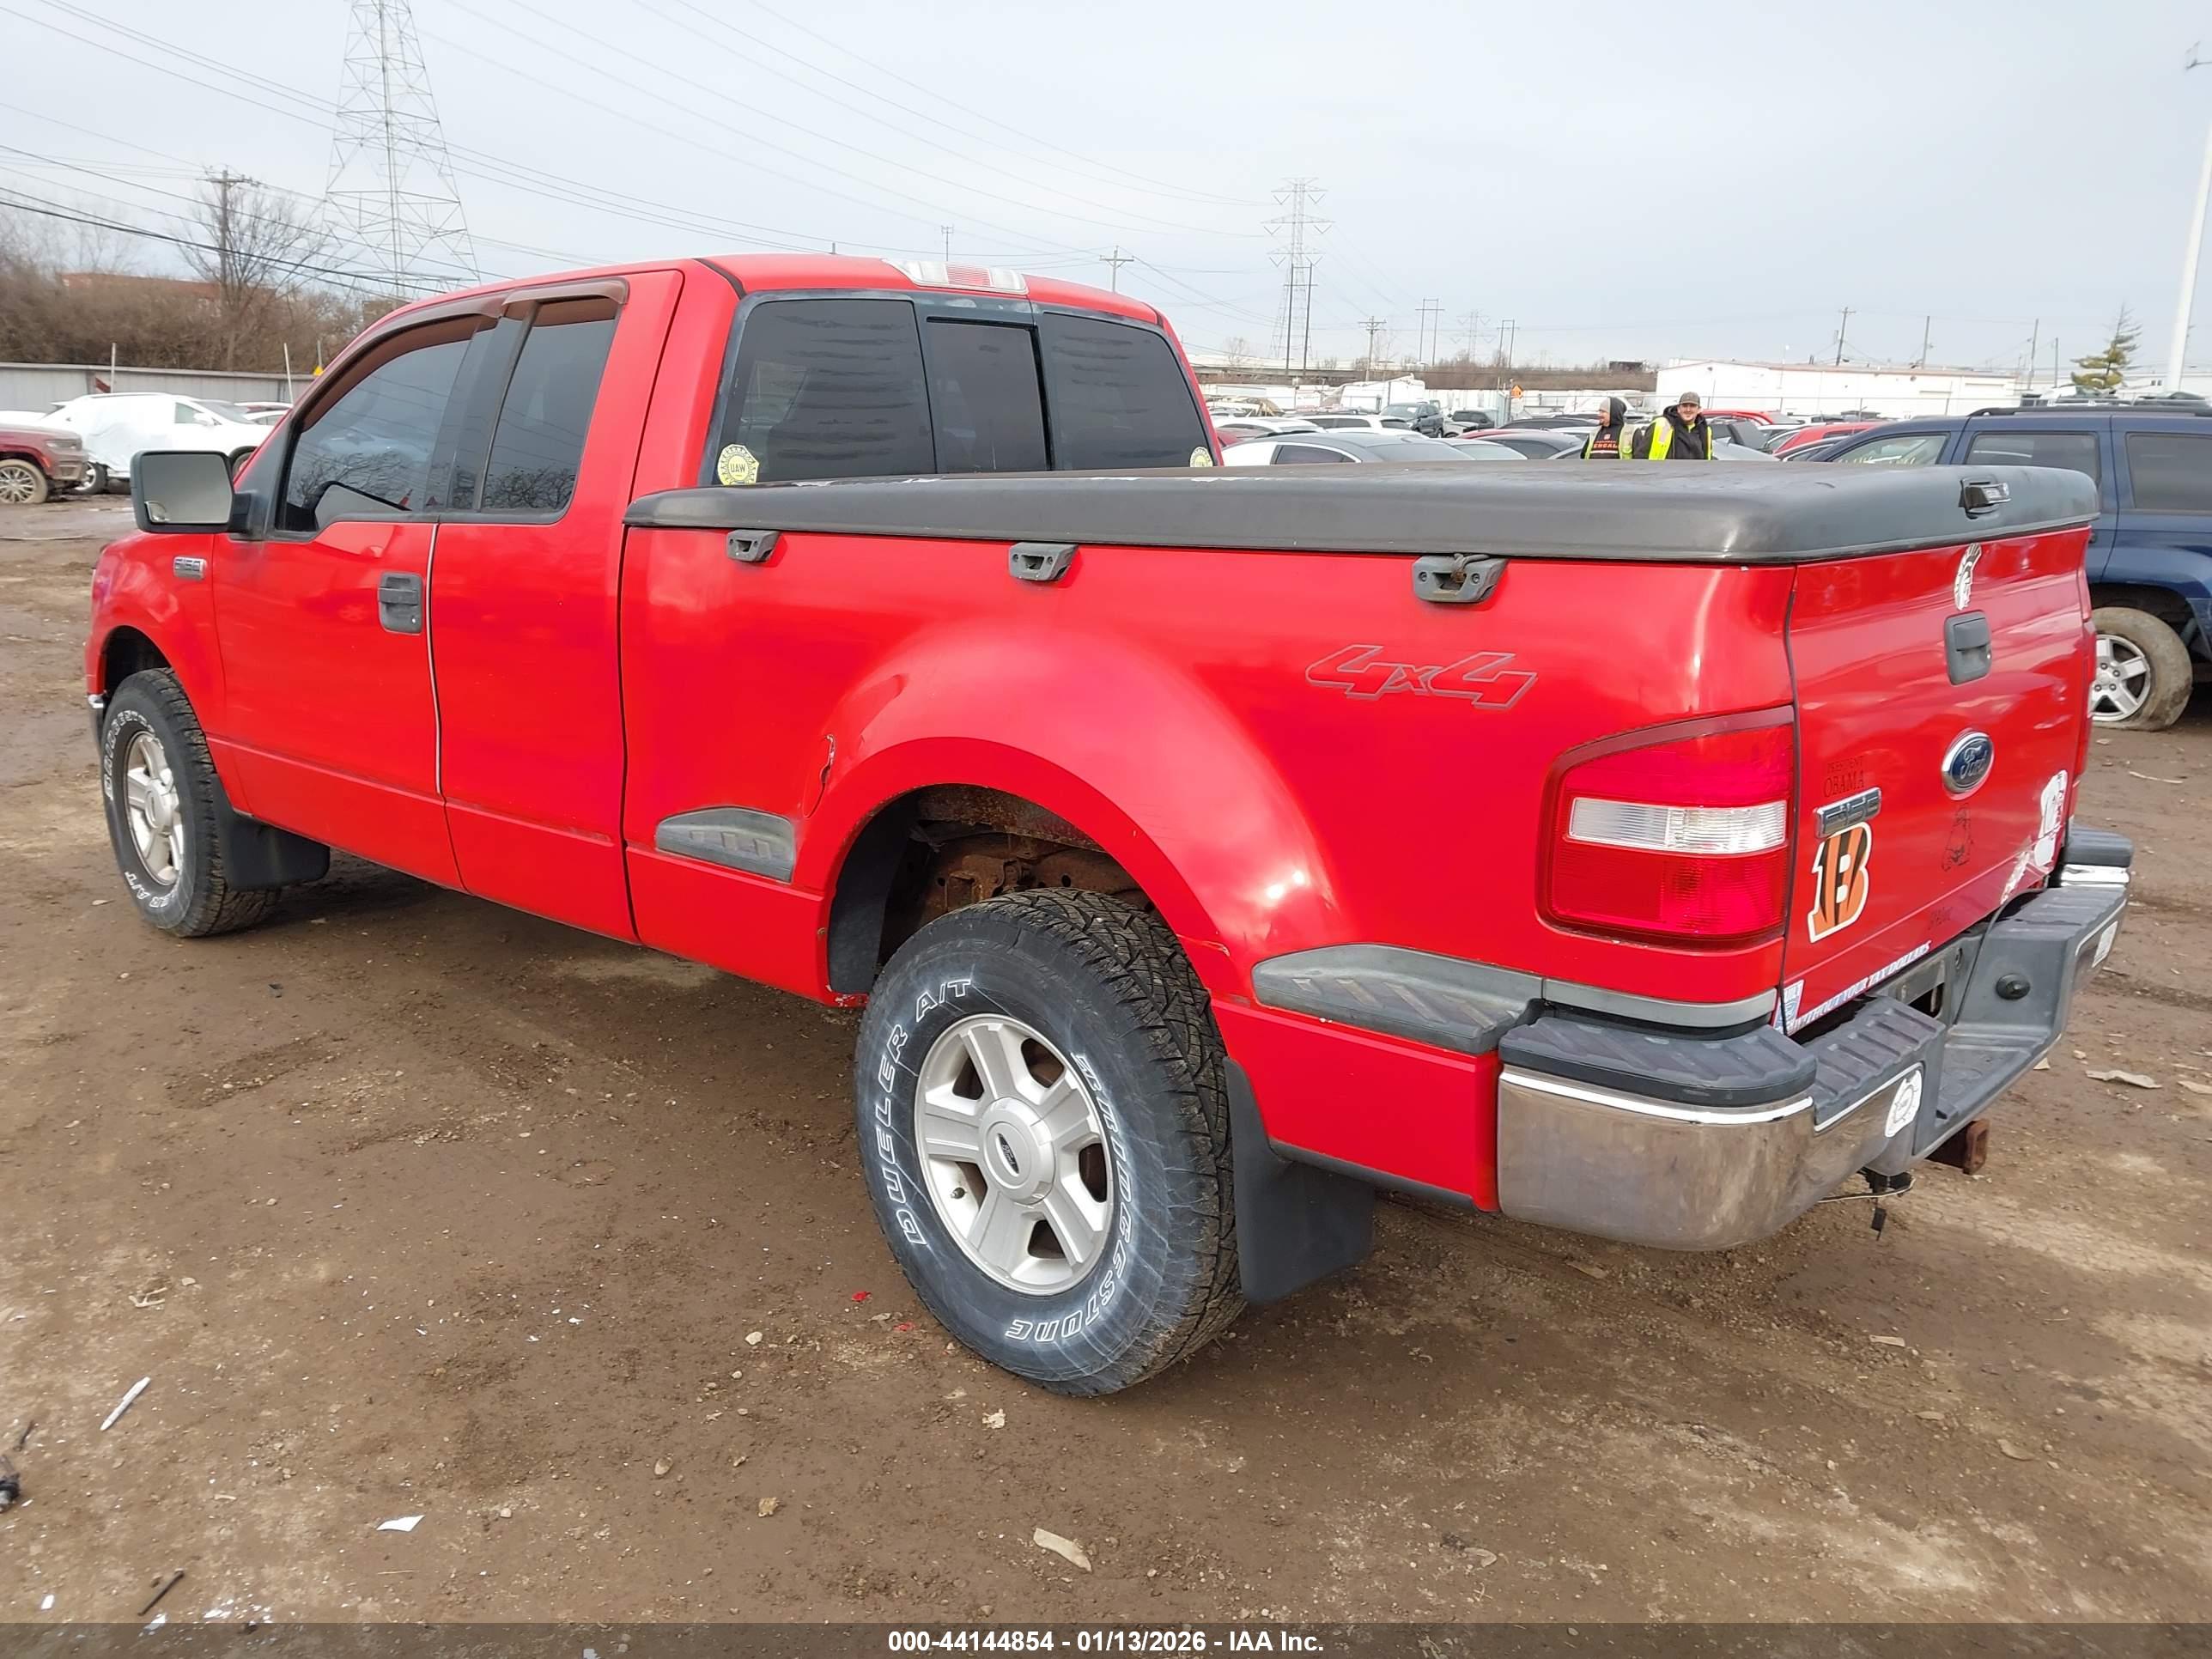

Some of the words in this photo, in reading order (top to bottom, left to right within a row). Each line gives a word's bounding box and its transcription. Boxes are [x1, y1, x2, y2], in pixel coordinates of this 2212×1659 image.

[730, 463, 746, 473] UAW
[1824, 769, 1864, 798] OBAMA
[1808, 821, 1873, 944] B
[873, 1024, 928, 1245] DUELER
[915, 979, 971, 1023] A/T
[1006, 1051, 1133, 1343] BRIDGESTONE
